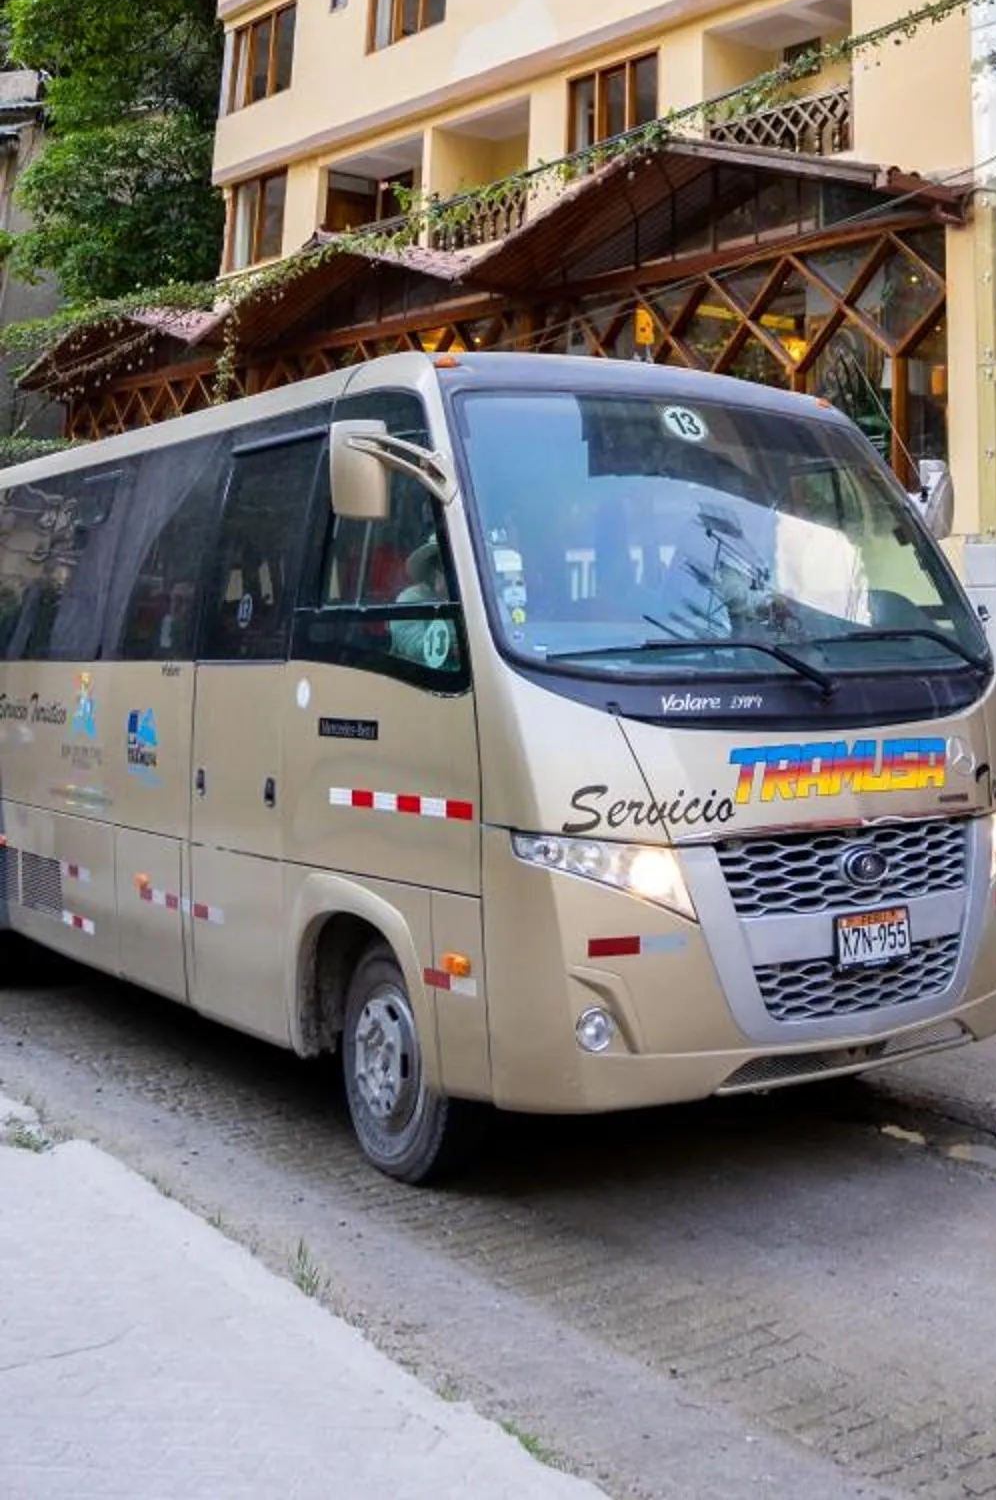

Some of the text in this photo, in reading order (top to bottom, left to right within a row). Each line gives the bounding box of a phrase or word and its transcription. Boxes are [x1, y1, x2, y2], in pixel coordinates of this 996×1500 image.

[669, 411, 701, 435] 13
[662, 693, 721, 715] Volare
[562, 785, 736, 833] Servicio
[729, 737, 945, 804] TRAMUSA
[842, 921, 907, 957] X7N-955
